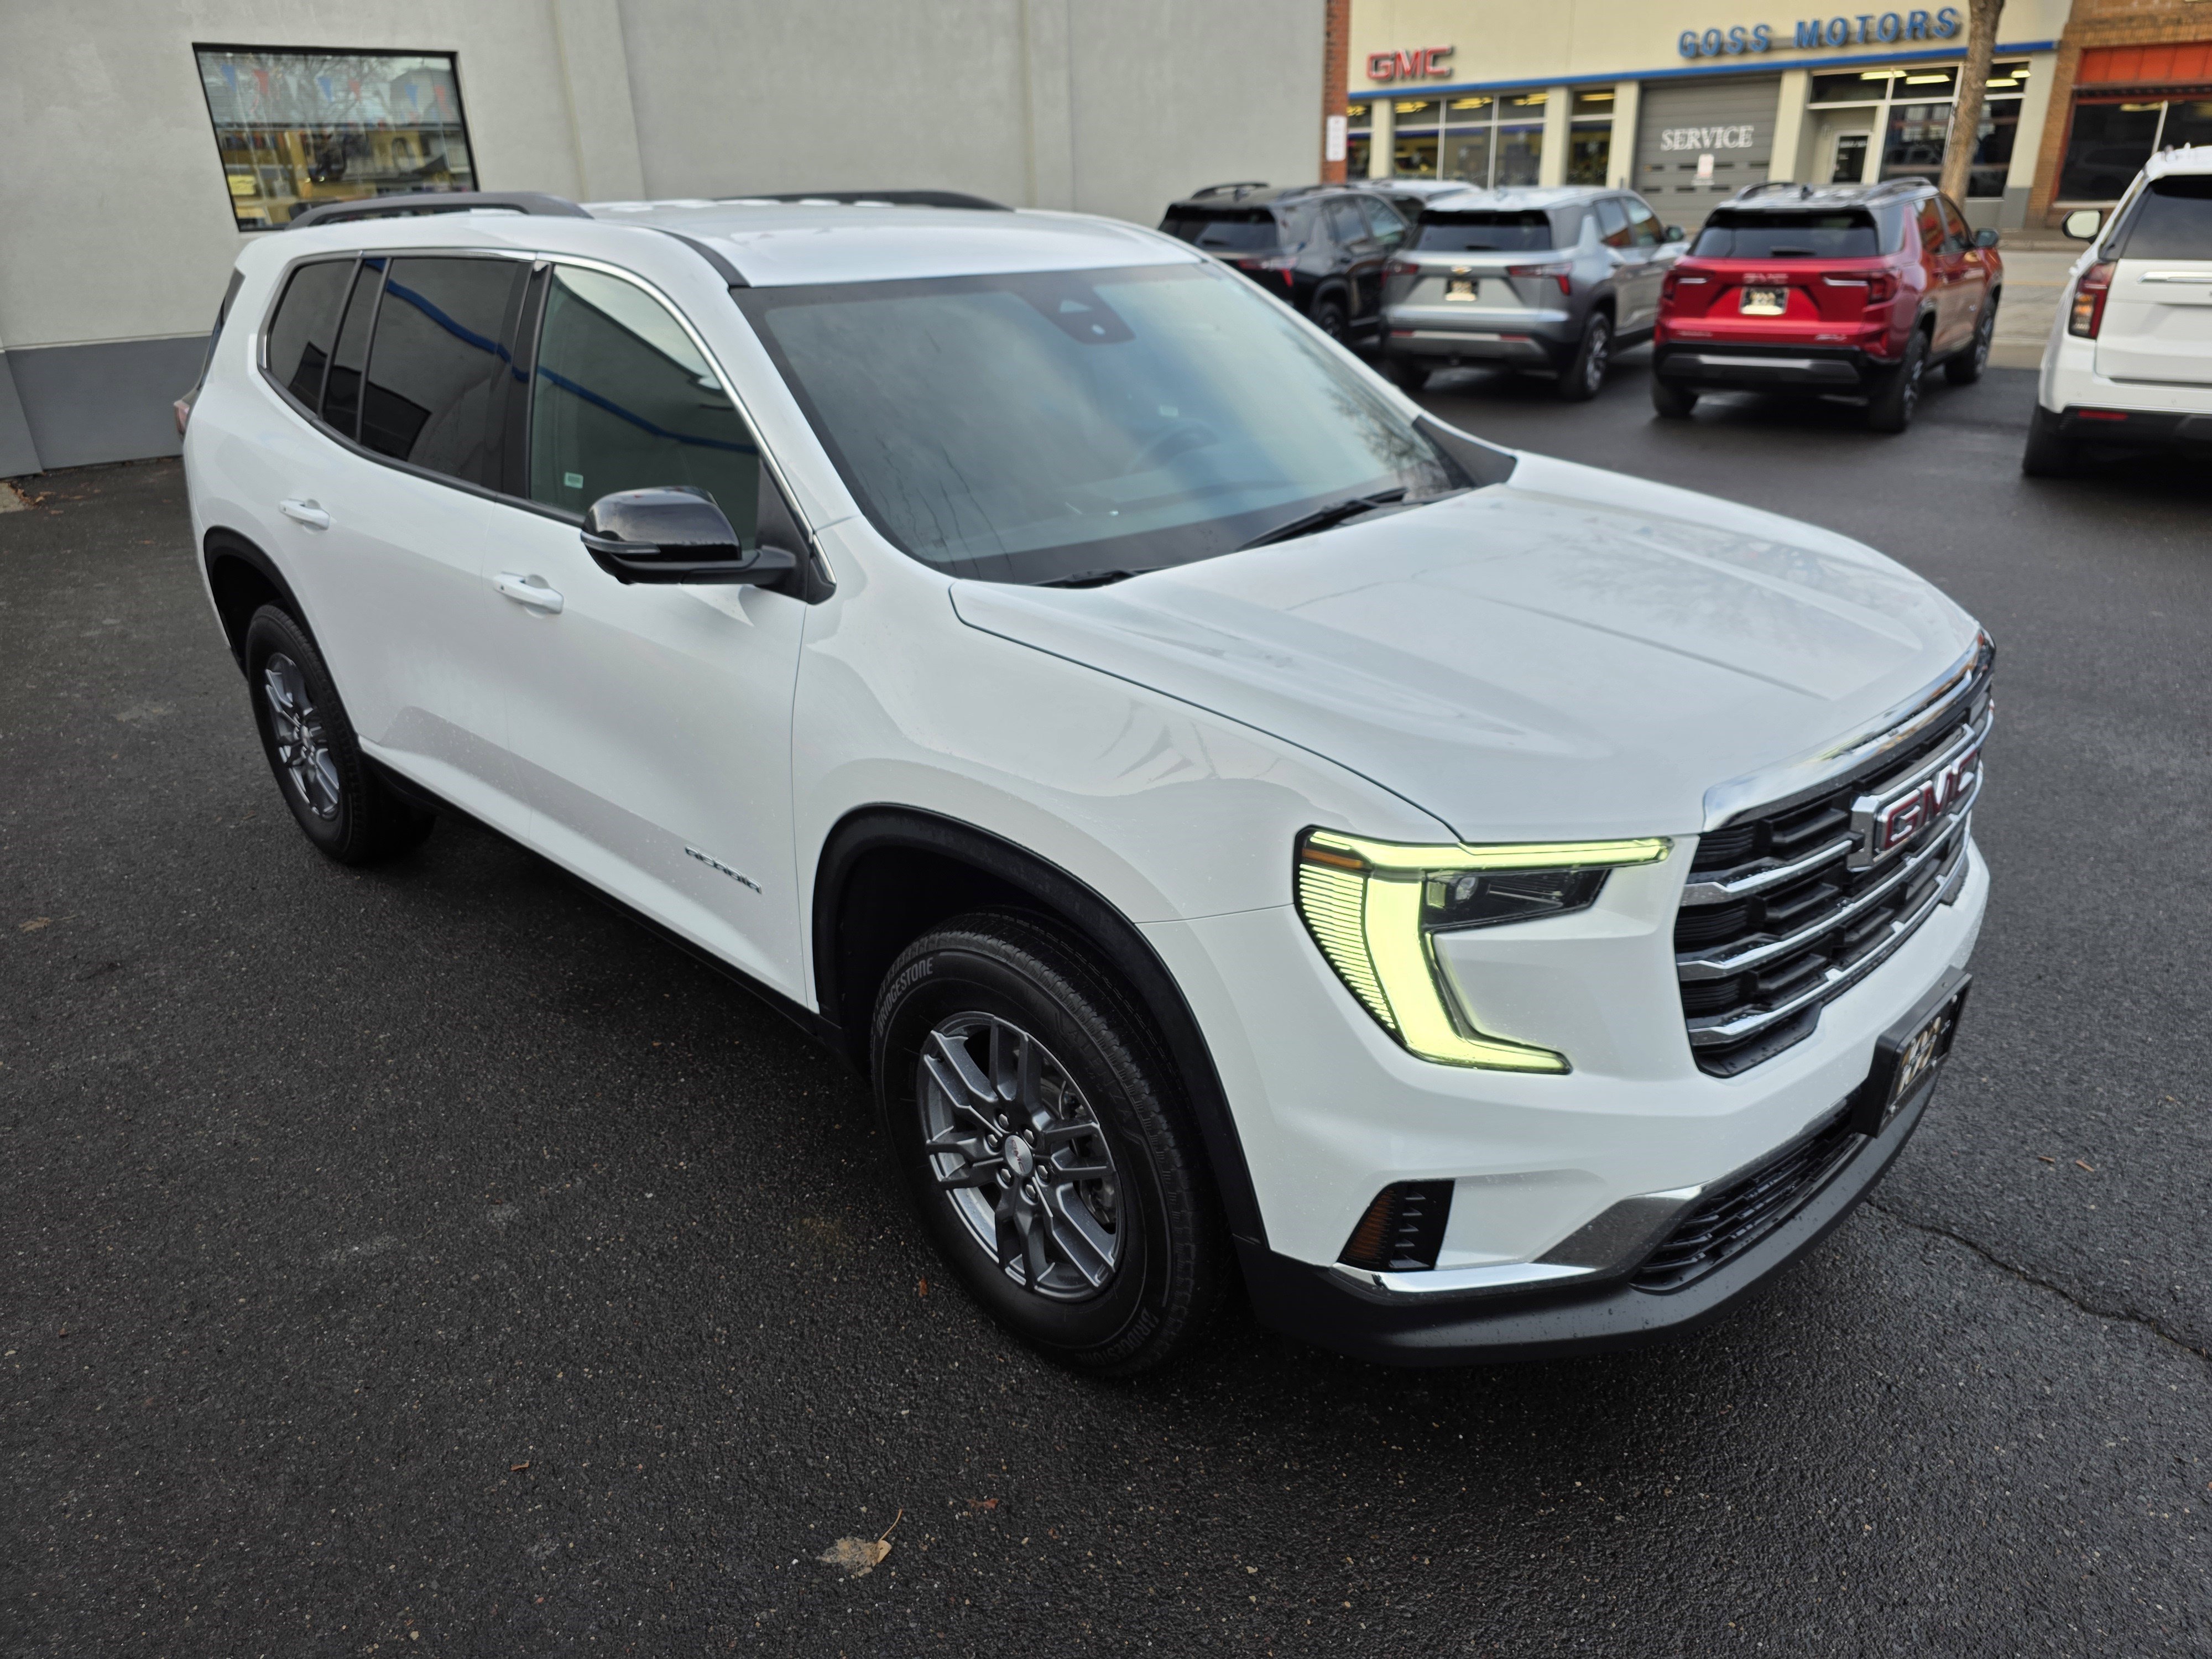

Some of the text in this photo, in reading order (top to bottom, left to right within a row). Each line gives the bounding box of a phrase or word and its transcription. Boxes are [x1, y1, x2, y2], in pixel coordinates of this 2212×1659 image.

[1678, 8, 1959, 57] GOSS MOTORS
[1367, 46, 1452, 80] GMC
[1660, 124, 1754, 151] SERVICE
[1876, 743, 1978, 850] GMC
[876, 956, 934, 1038] BRIDGESTONE
